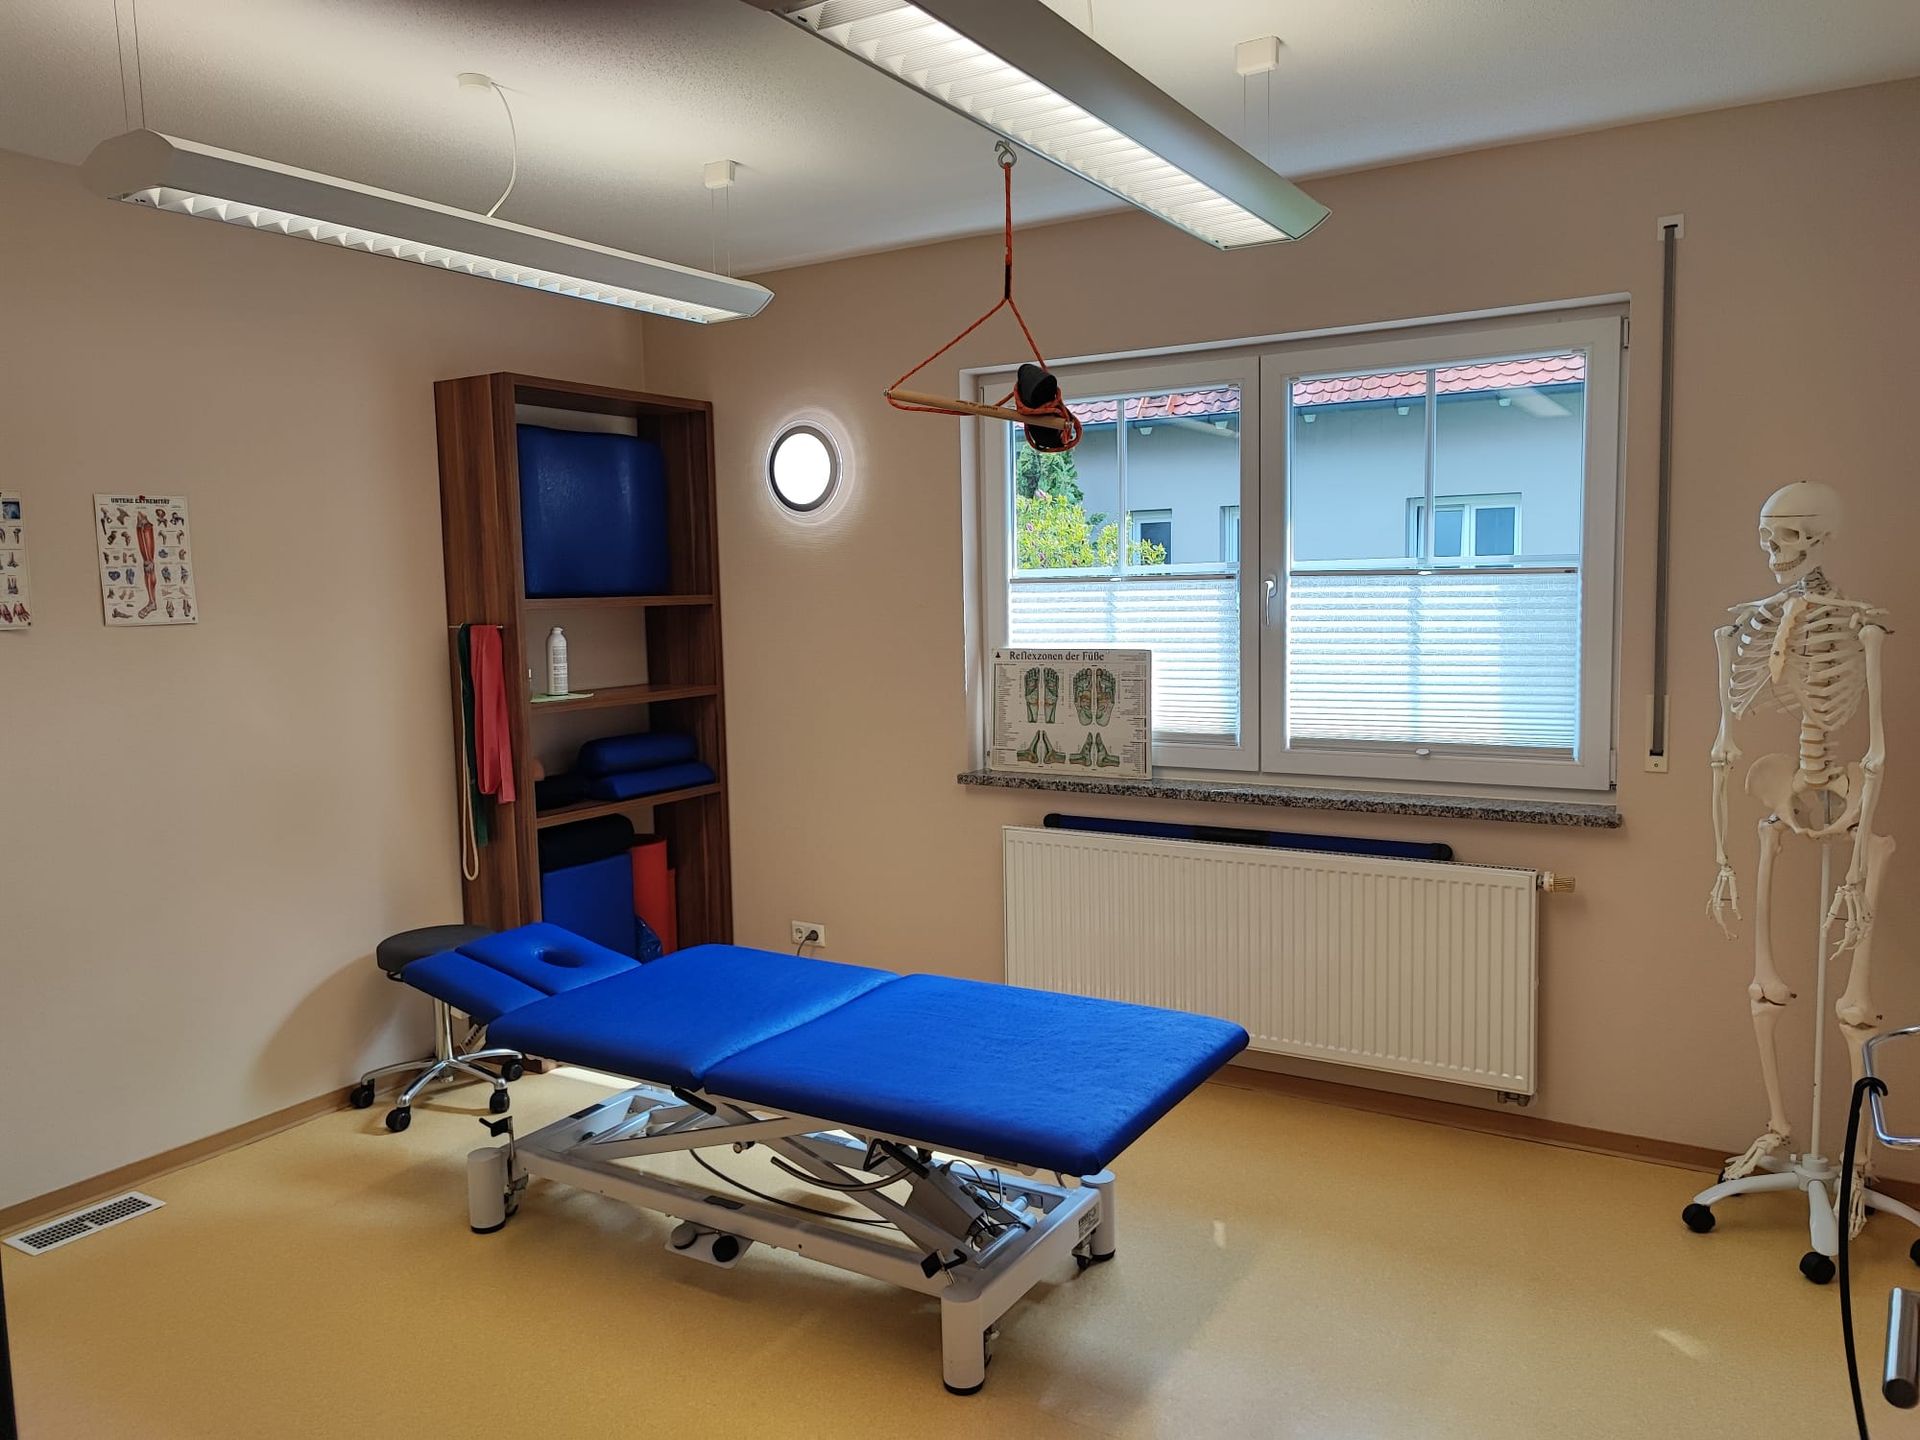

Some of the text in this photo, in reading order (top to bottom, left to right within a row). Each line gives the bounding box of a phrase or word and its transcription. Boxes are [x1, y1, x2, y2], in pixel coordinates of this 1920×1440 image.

[1009, 651, 1104, 661] Reflexzonen der Füße
